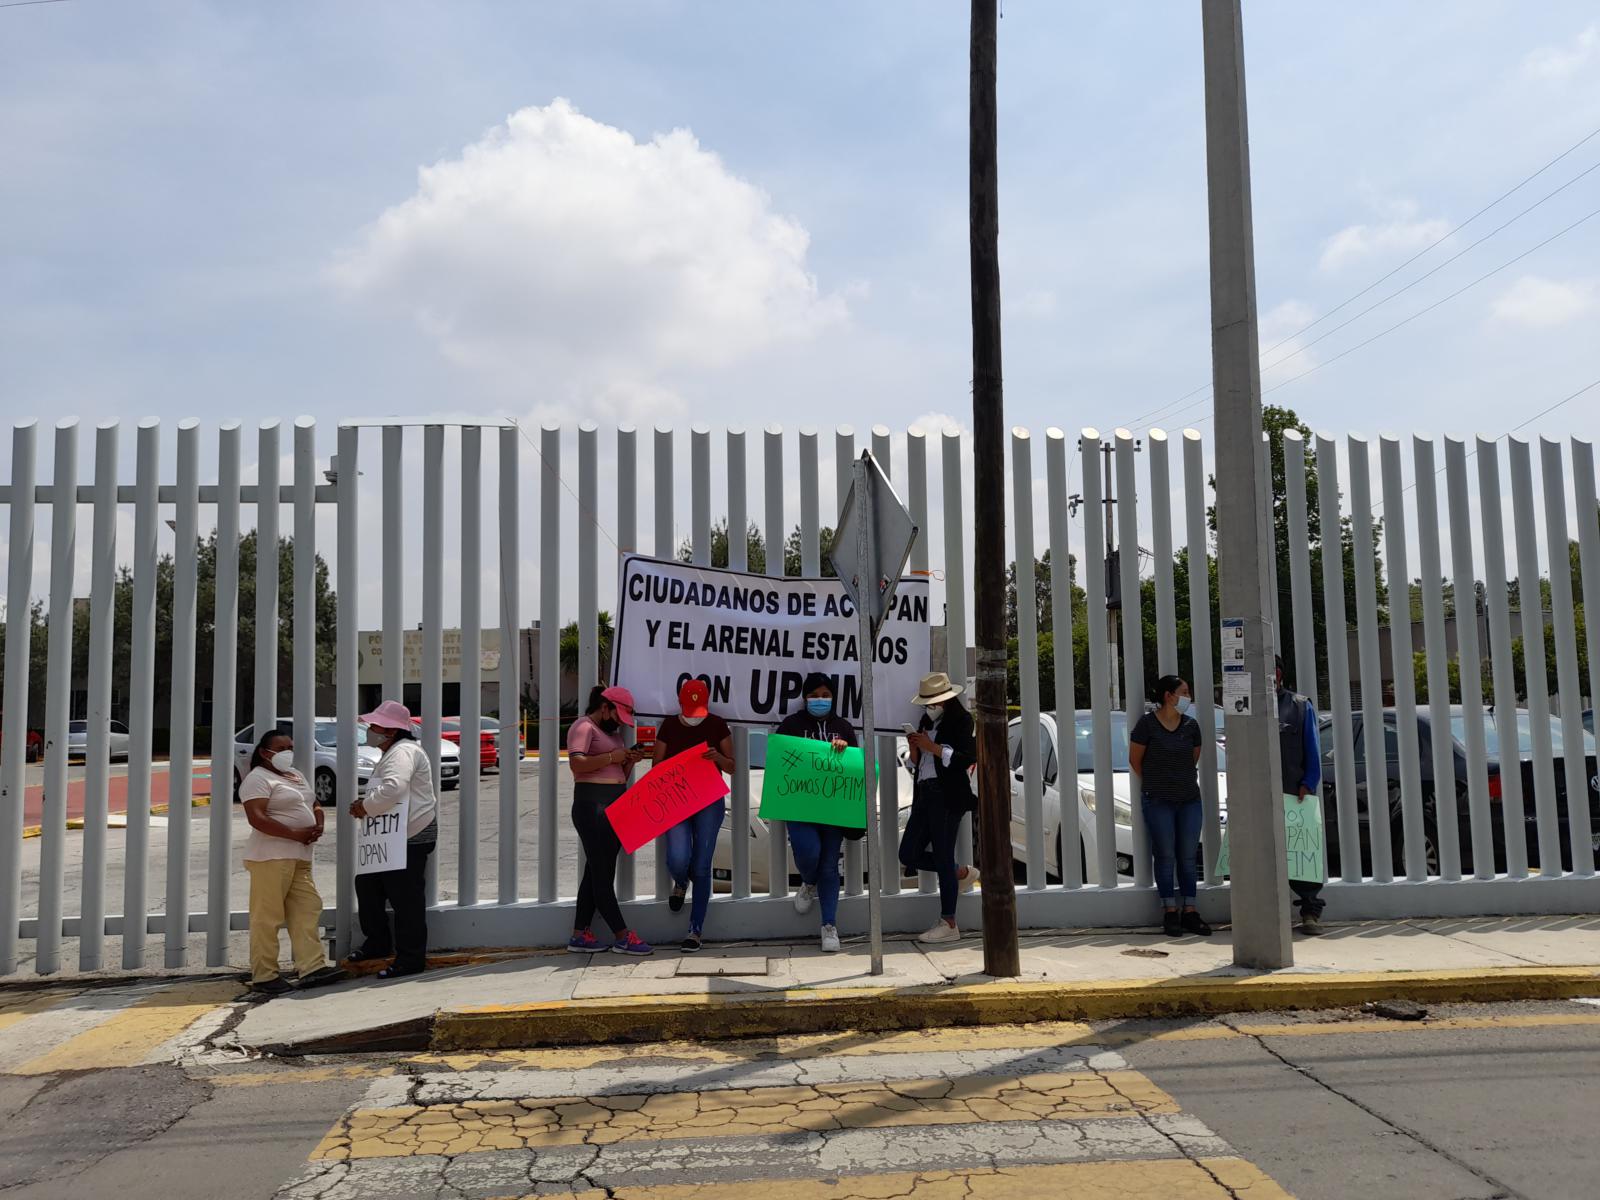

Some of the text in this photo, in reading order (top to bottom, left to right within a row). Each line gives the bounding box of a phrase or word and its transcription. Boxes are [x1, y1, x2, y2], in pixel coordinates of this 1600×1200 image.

[629, 573, 928, 623] CIUDADANOS DE ACPAN
[645, 619, 908, 665] Y EL ARENAL ESTAOS
[750, 669, 863, 719] UPIM
[808, 751, 844, 774] Todos
[777, 774, 864, 802] Somos UPFIM
